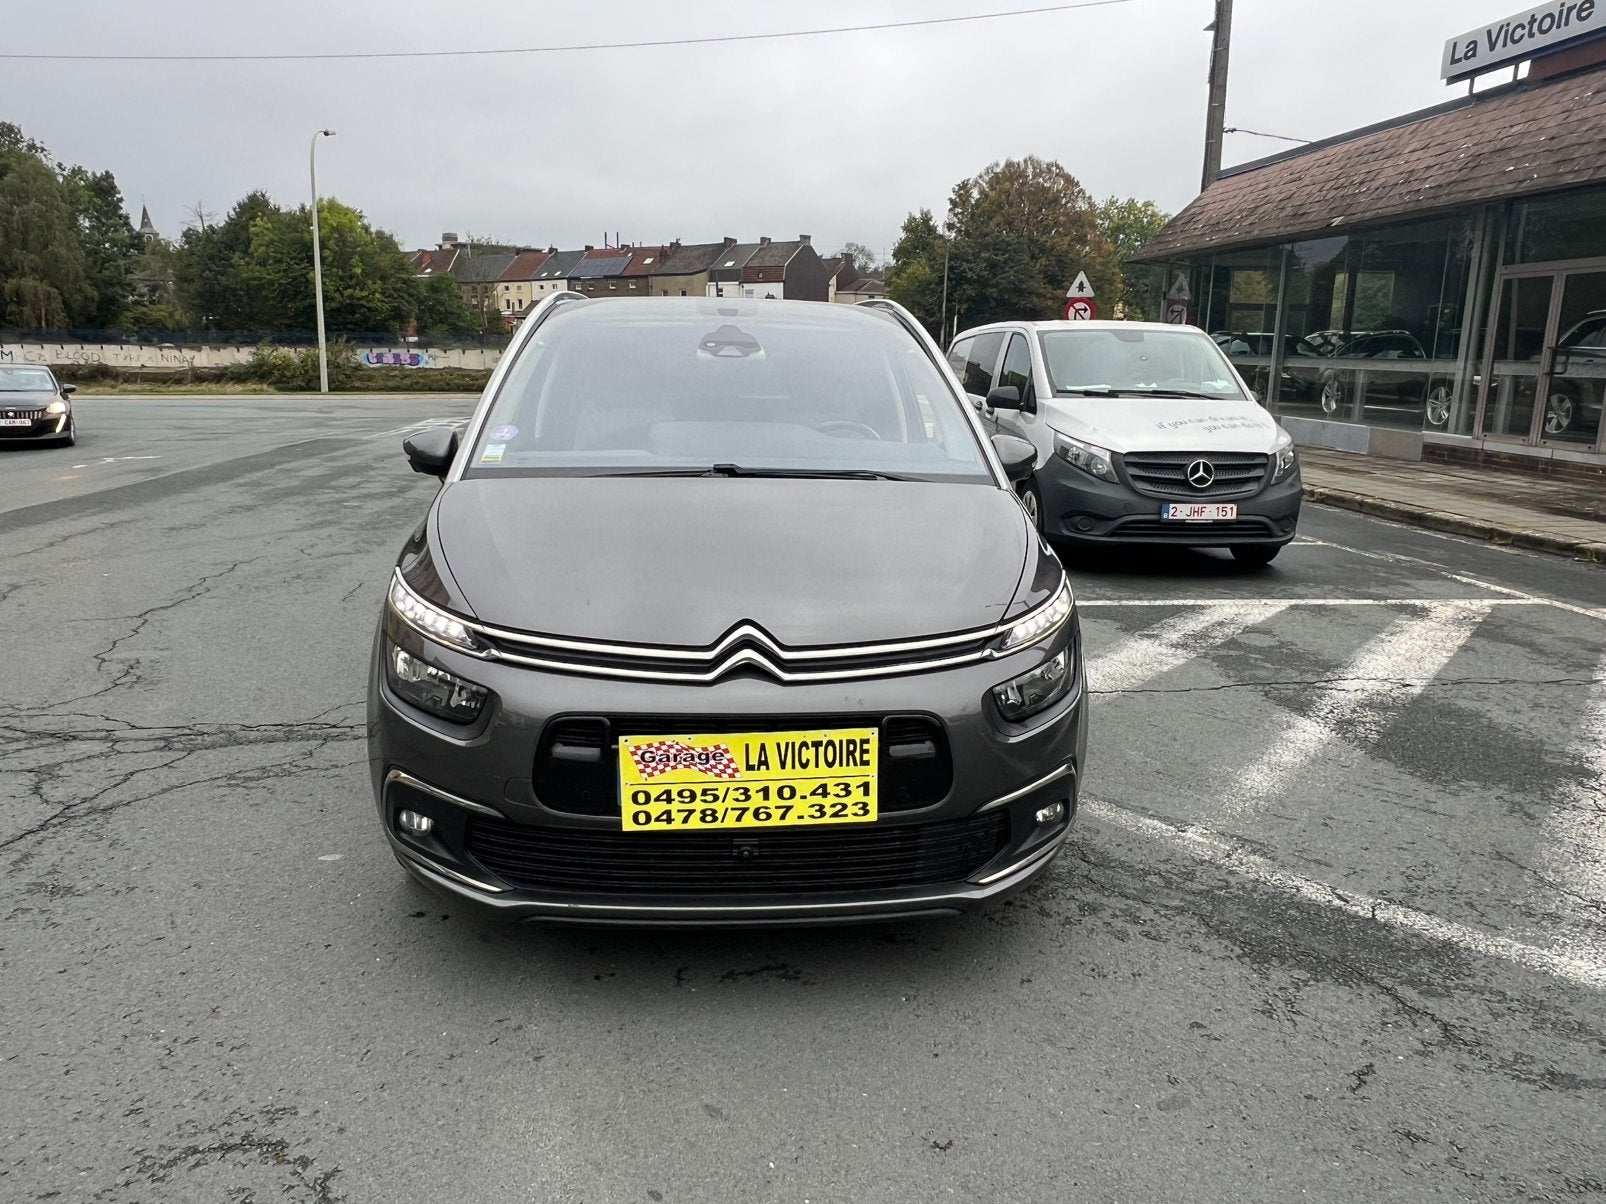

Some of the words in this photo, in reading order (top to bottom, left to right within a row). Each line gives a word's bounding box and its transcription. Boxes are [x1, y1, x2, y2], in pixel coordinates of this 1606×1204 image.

[1449, 39, 1478, 66] La
[1486, 0, 1595, 52] Victoire
[640, 750, 725, 766] Garage
[744, 742, 770, 772] LA
[776, 737, 871, 770] VICTOIRE
[631, 781, 871, 806] 0495/310.431
[631, 801, 871, 826] 0478/767.323
